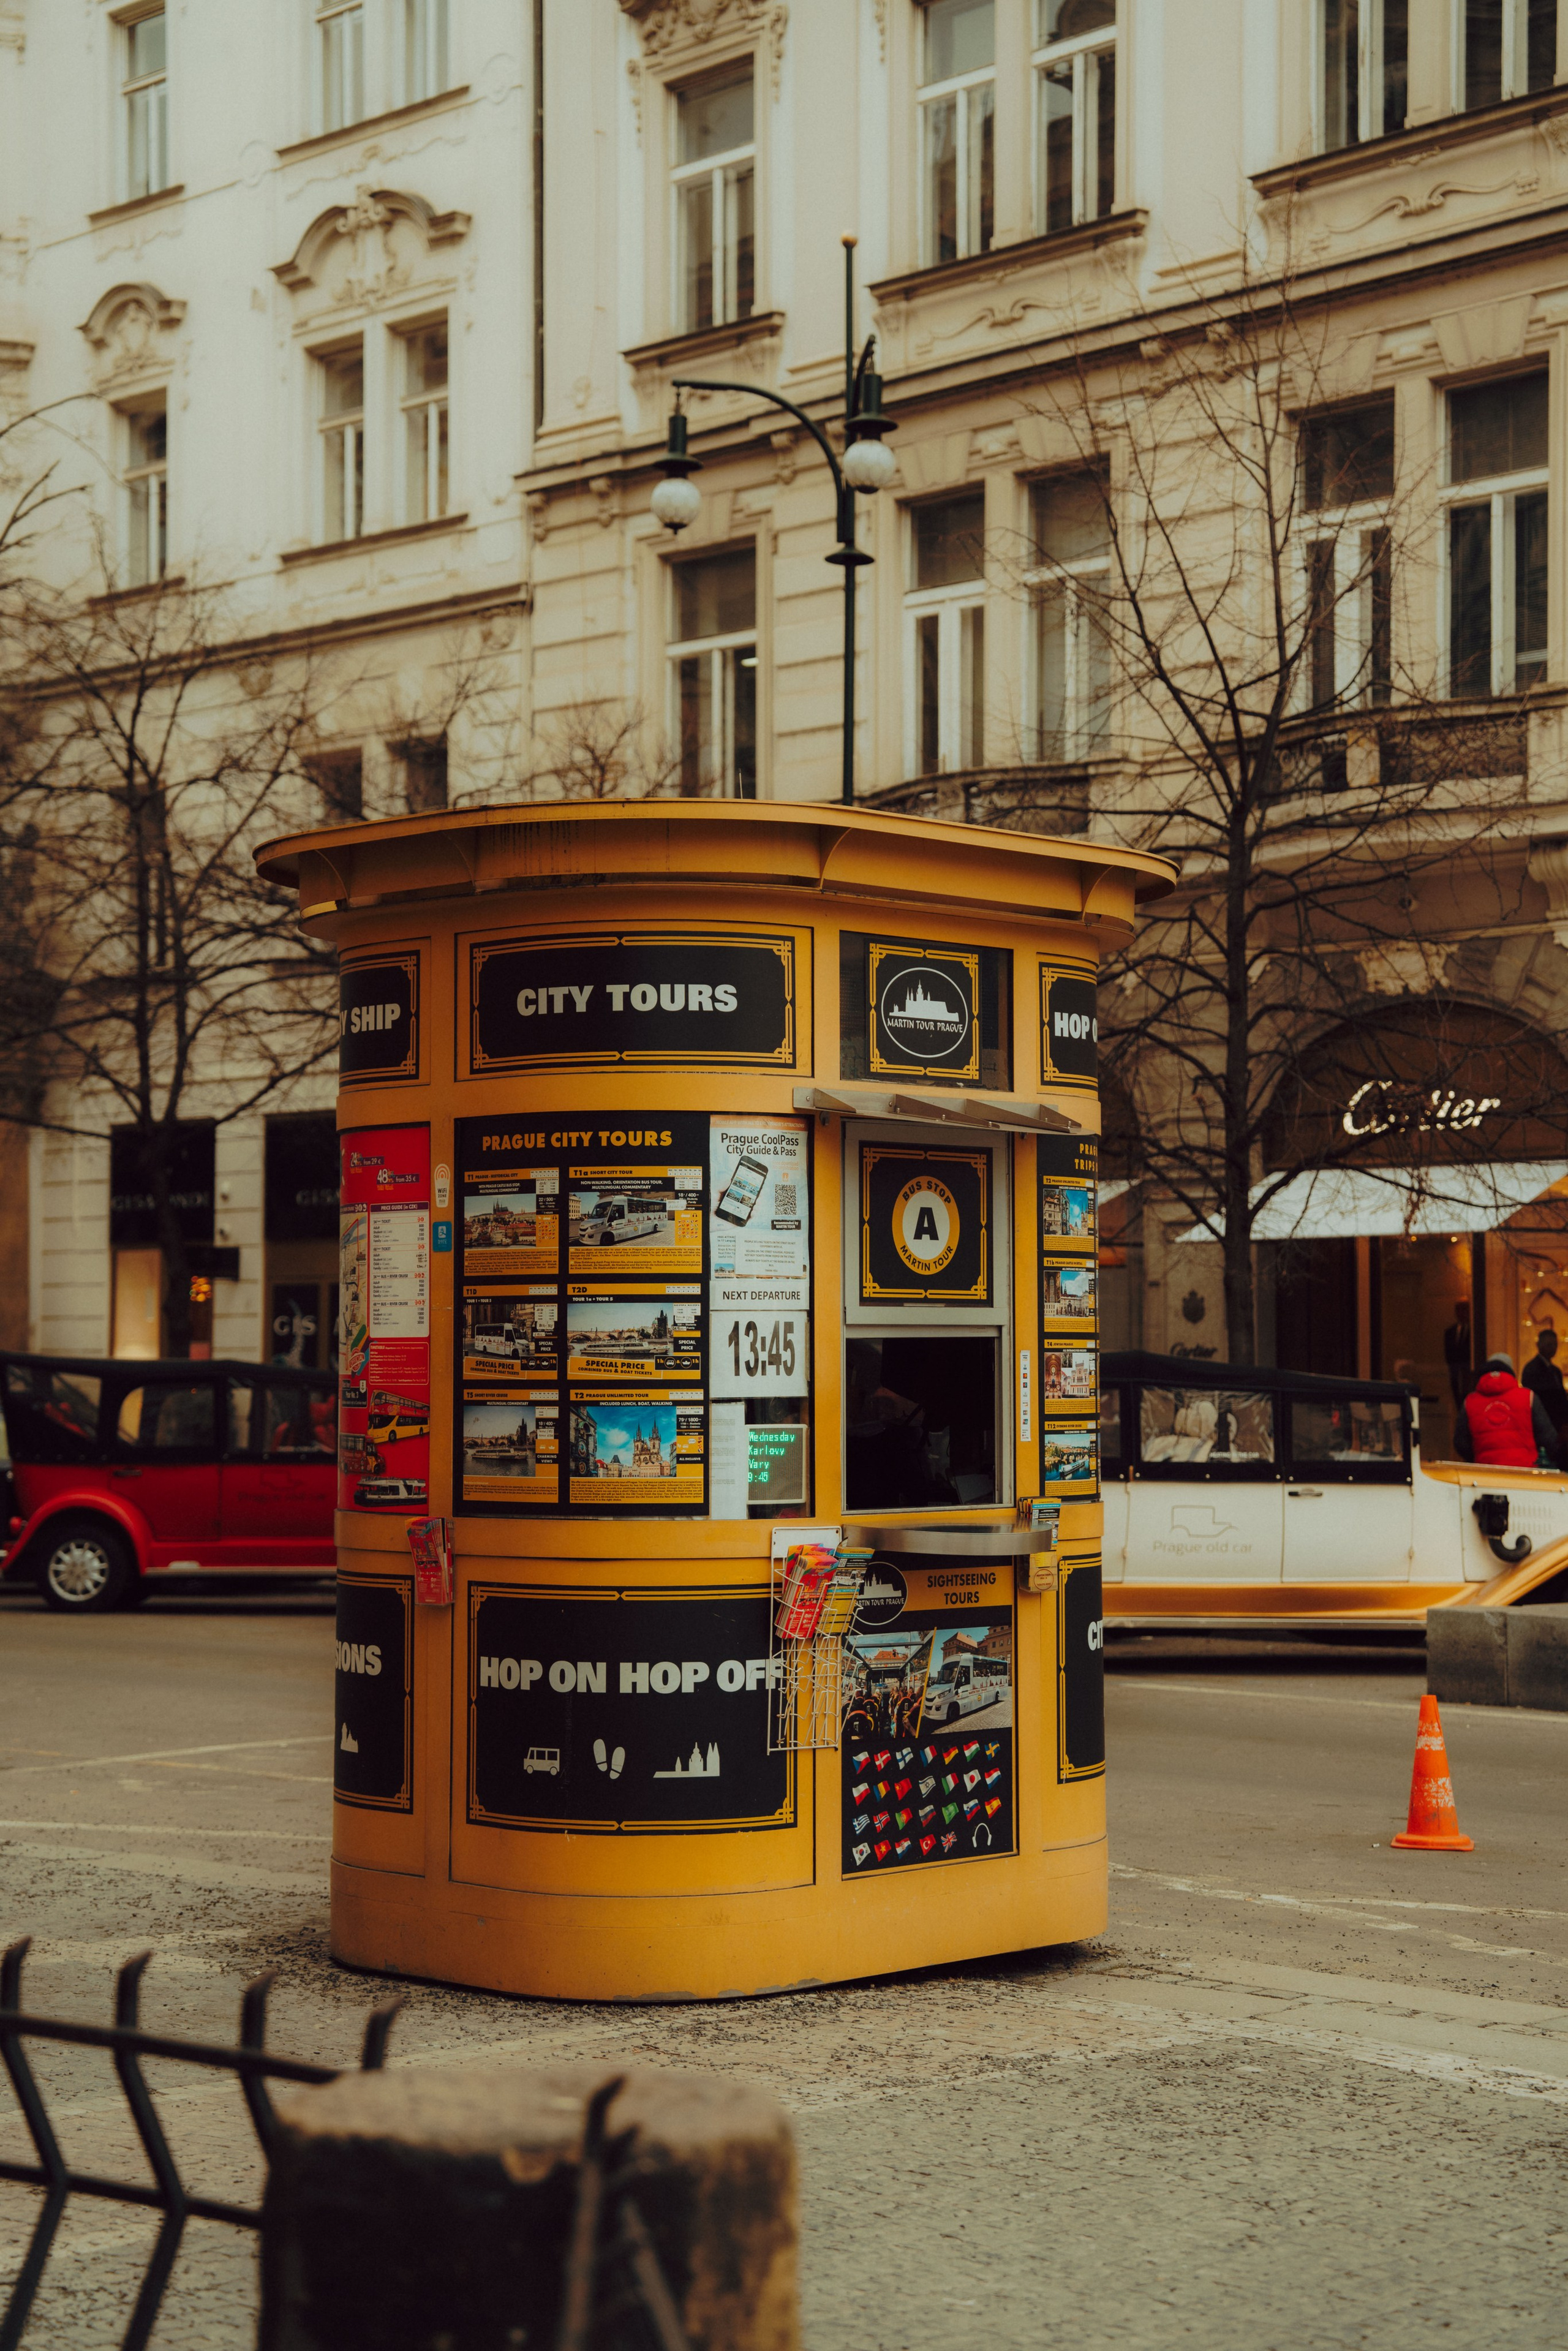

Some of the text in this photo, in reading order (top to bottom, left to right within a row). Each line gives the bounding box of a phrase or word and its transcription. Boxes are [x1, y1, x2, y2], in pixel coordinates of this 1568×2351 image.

[516, 983, 737, 1016] CITY TOURS
[351, 1003, 401, 1033] SHIP
[887, 1017, 963, 1033] MARTIN TOUR PRAGUE
[1054, 1012, 1098, 1043] HOP O
[482, 1131, 673, 1151] PRAGUE CITY TOURS
[721, 1133, 799, 1146] Prague CoolPass
[726, 1144, 796, 1156] City Guide & Pass
[350, 1152, 356, 1166] 24
[1074, 1158, 1095, 1171] TRIPS
[377, 1169, 388, 1183] 48
[902, 1180, 952, 1205] BUS STOP
[913, 1206, 940, 1240] A
[900, 1244, 954, 1272] MARTIN TOUR
[723, 1291, 801, 1300] NEXT DEPARTURE
[728, 1321, 796, 1376] 13:45
[748, 1432, 796, 1443] Wednesday
[748, 1446, 785, 1457] Karlovy
[748, 1459, 769, 1470] Vary
[1153, 1540, 1252, 1557] Prague old car
[927, 1572, 997, 1588] SIGHTSEEING
[944, 1591, 979, 1605] TOURS
[480, 1656, 785, 1694] HOP ON HOP OFF
